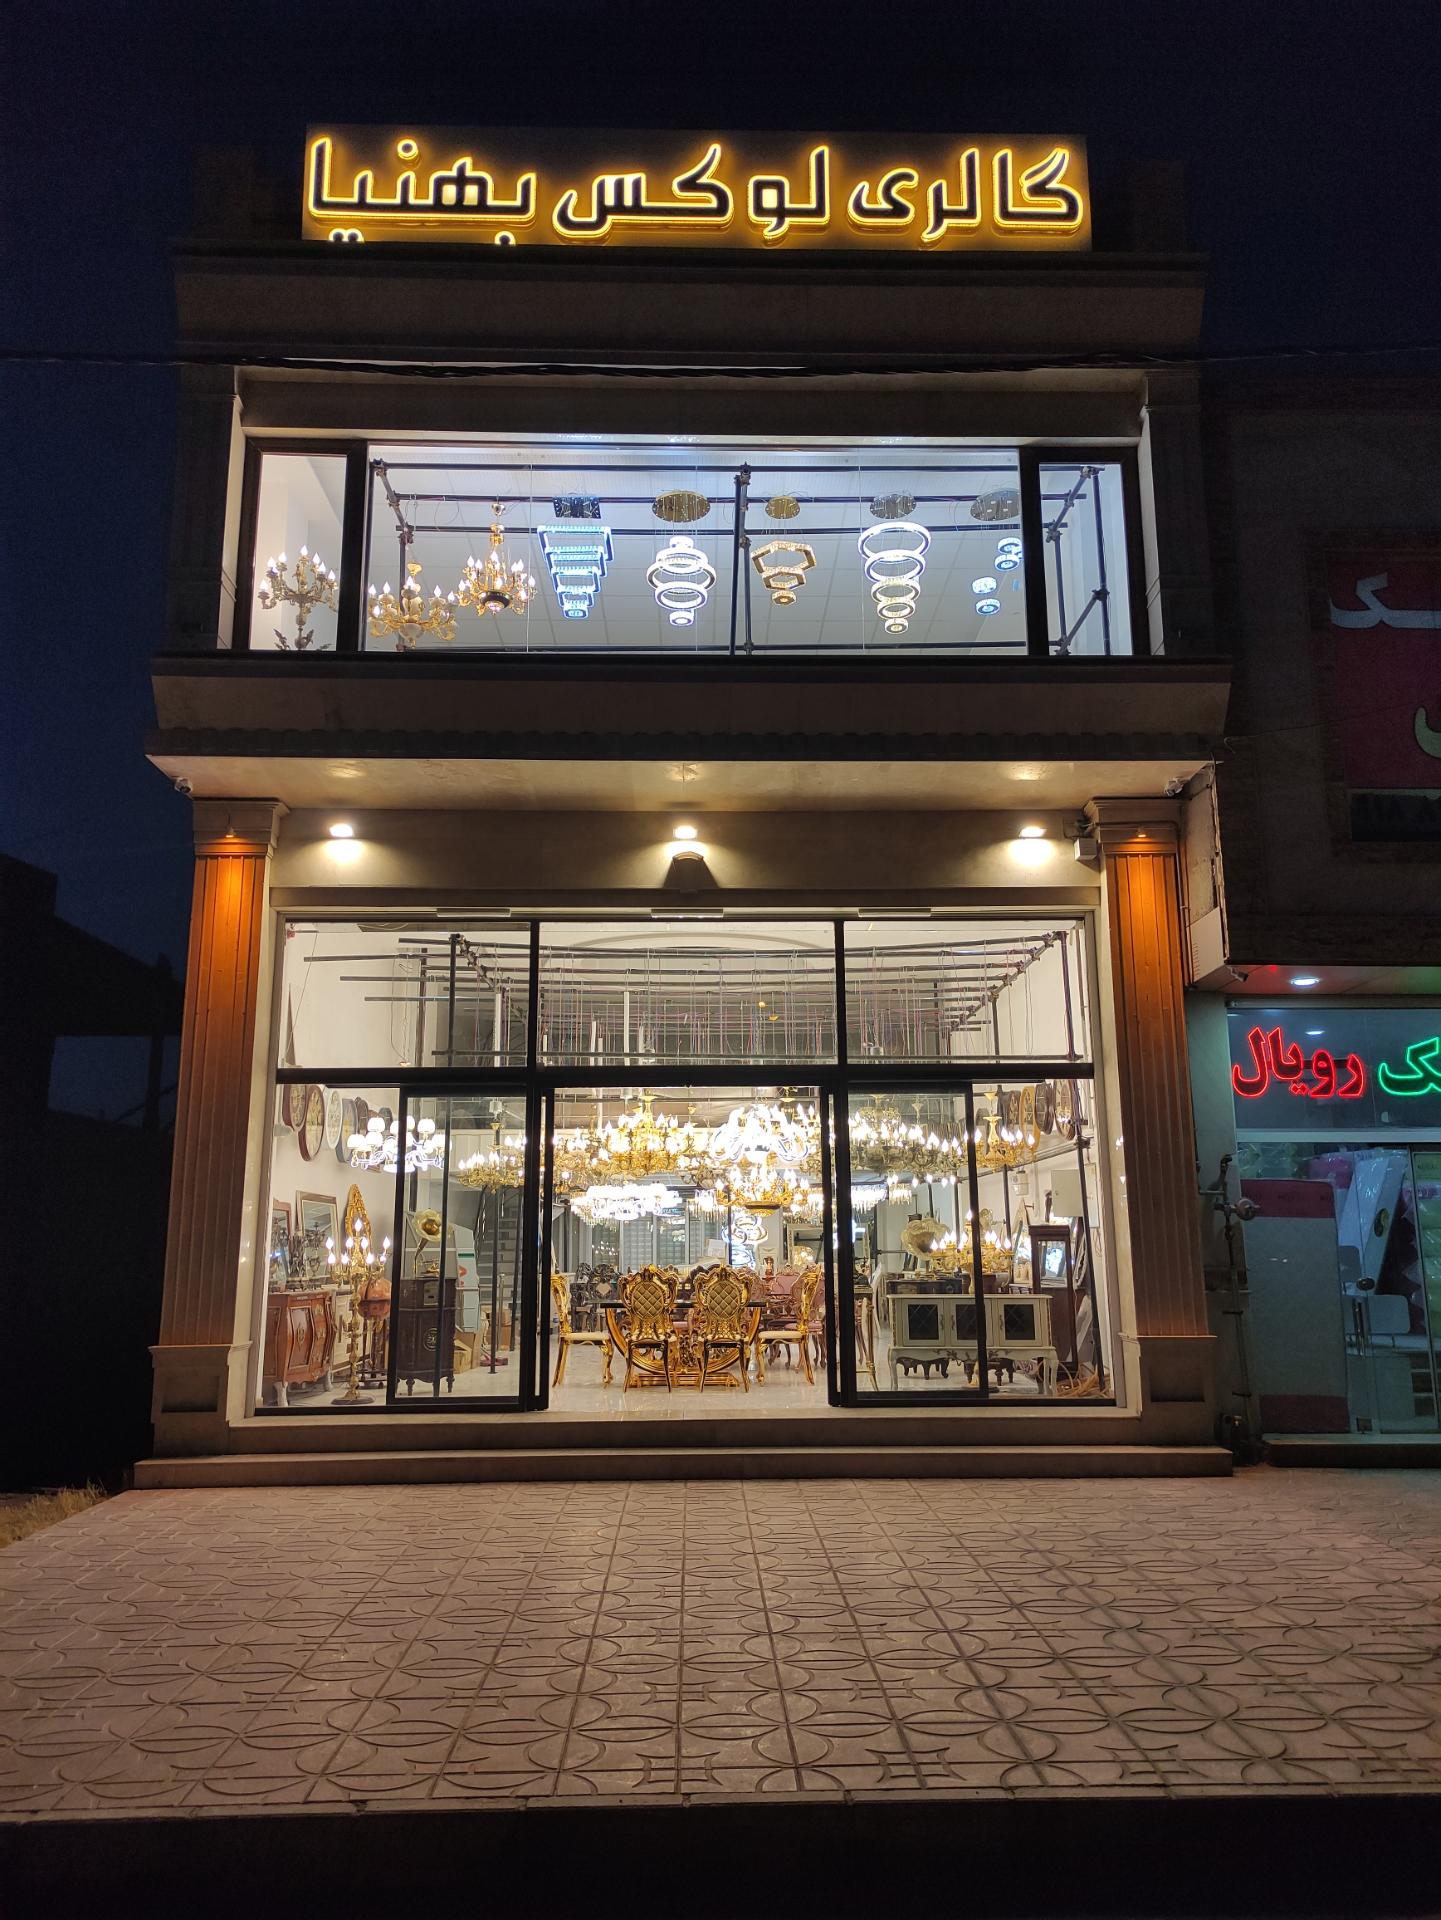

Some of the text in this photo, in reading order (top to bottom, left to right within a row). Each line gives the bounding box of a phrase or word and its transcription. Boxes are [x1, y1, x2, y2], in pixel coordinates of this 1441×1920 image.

[309, 136, 1083, 246] گالری لوکس بهنیا
[1232, 1027, 1364, 1097] رویال
